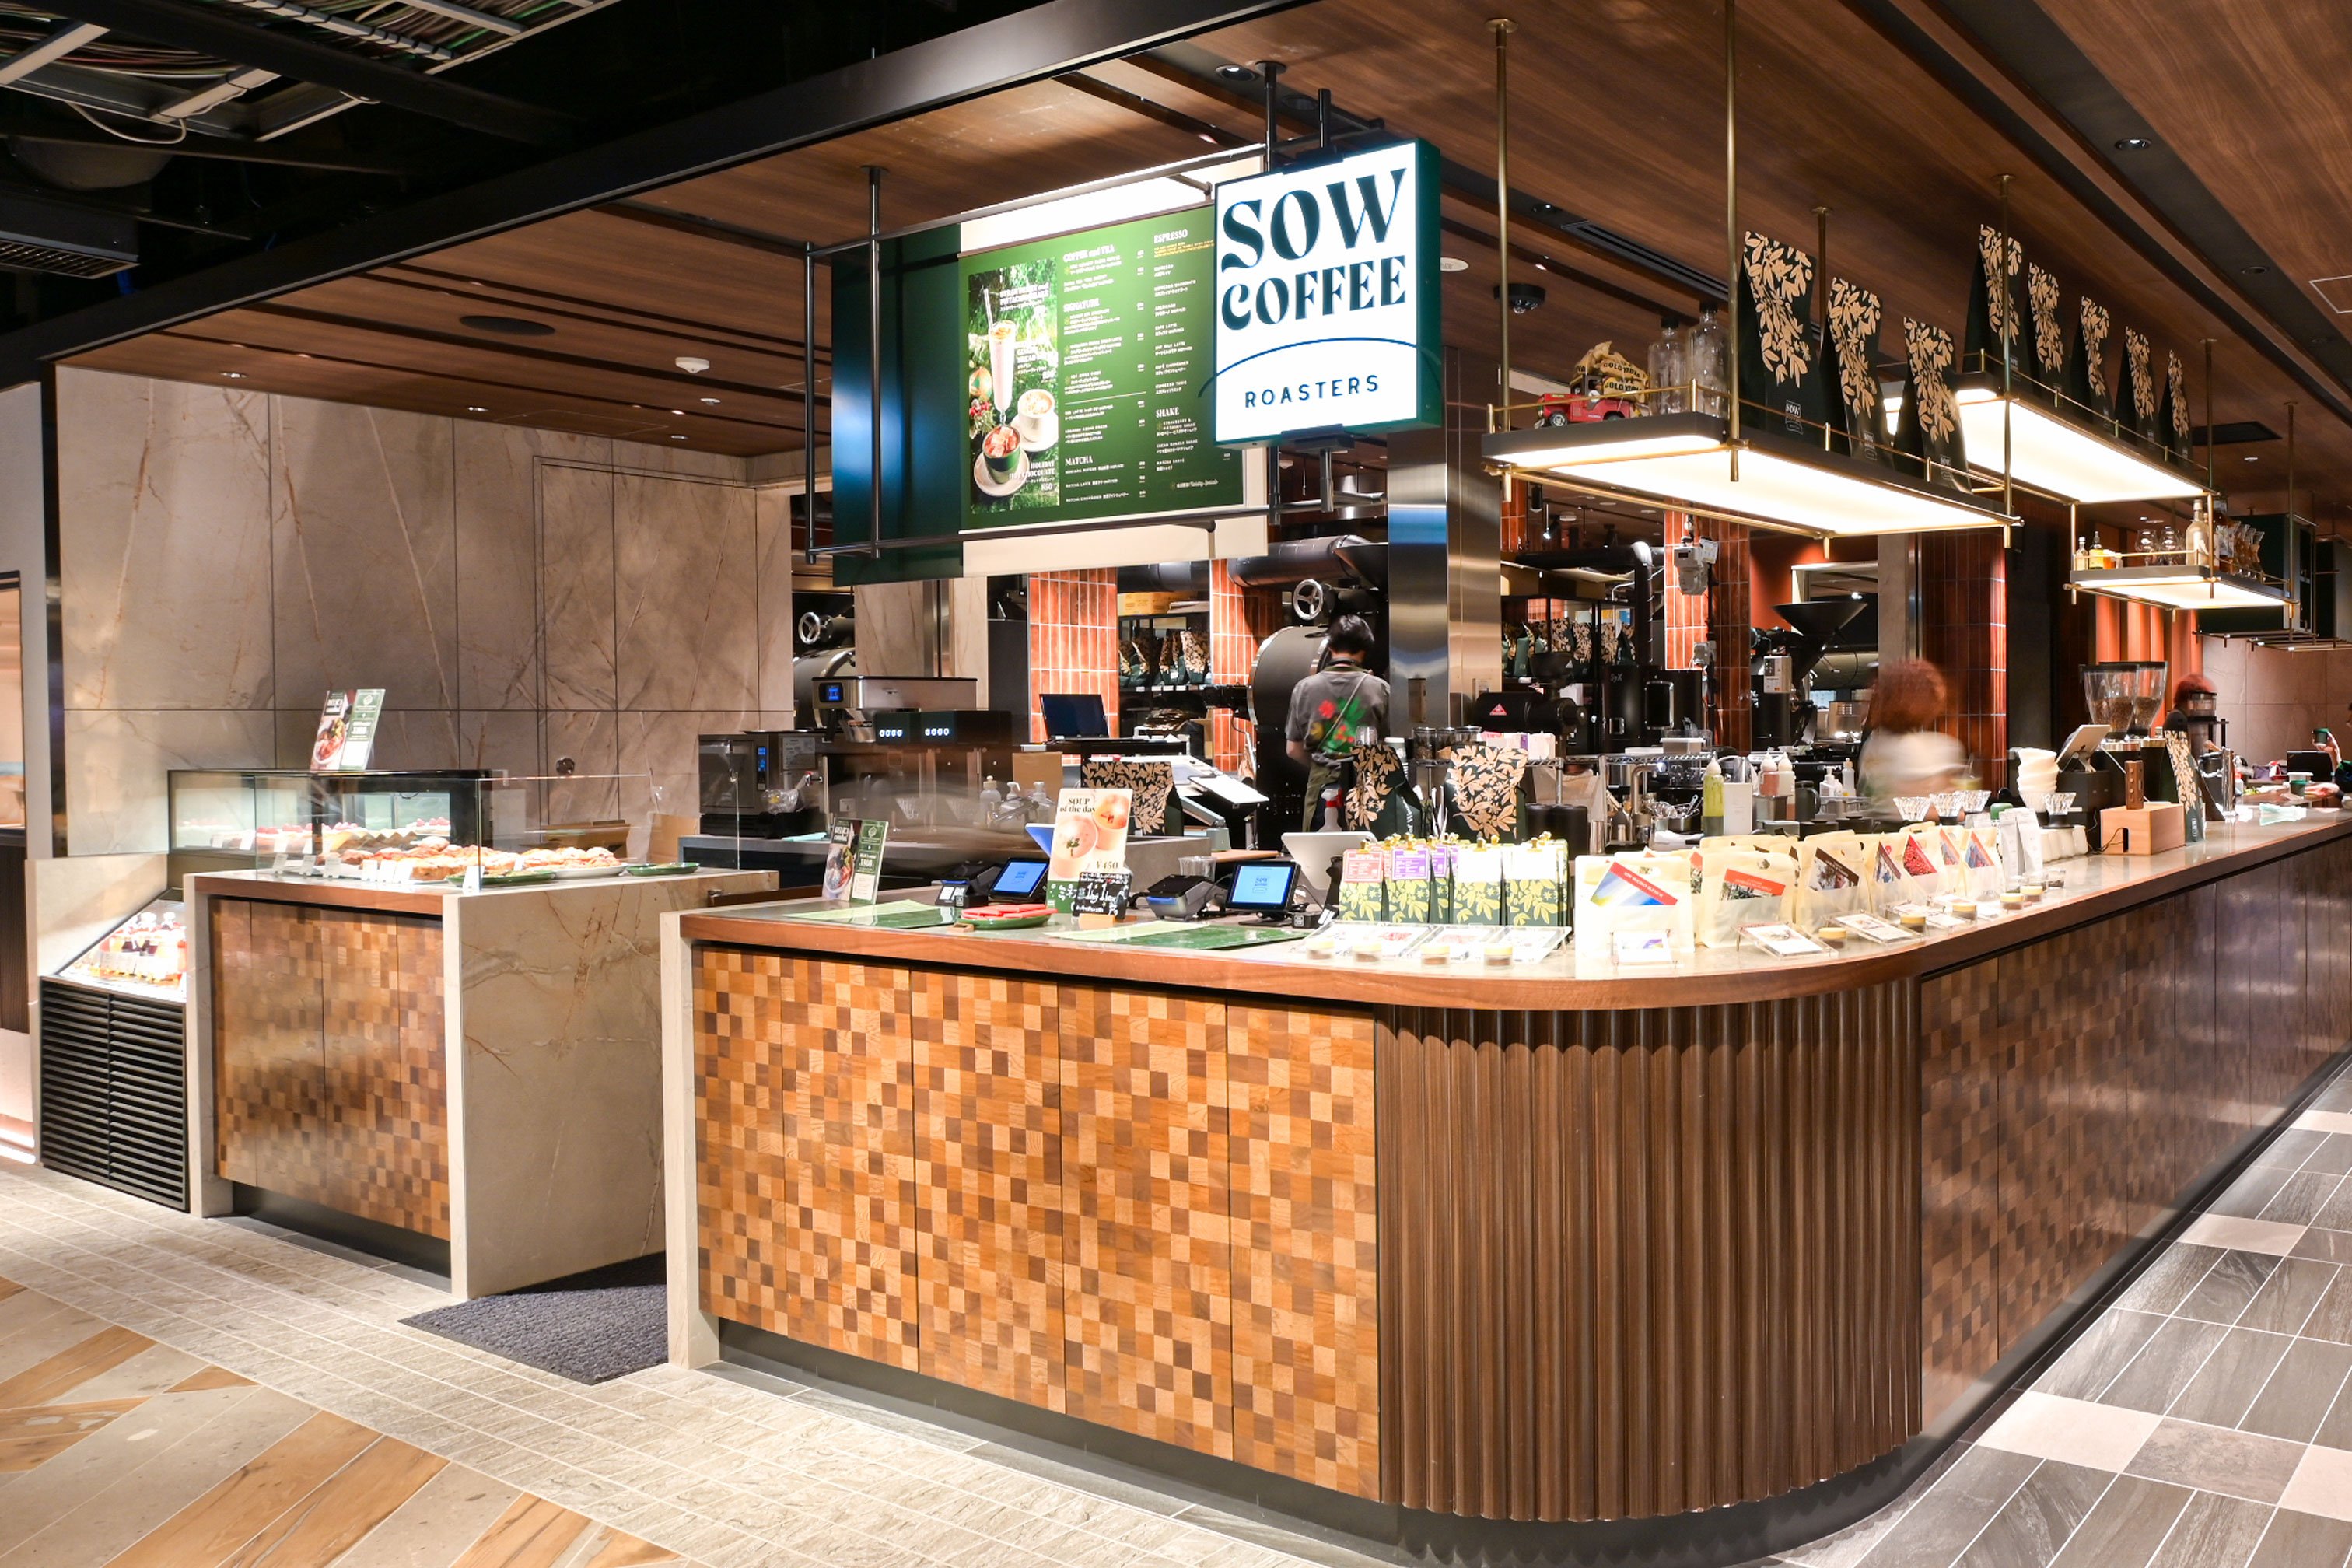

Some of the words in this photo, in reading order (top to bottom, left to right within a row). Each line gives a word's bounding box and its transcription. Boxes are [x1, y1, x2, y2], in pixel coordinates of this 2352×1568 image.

[1221, 167, 1407, 274] SOW
[1154, 229, 1188, 244] ESPRESSO
[1063, 250, 1088, 262] COFFEE
[1101, 243, 1115, 254] TEA
[1222, 255, 1405, 331] COFFEE
[1063, 298, 1099, 313] SIGNATURE
[1603, 362, 1640, 378] COLOMBIA
[1245, 375, 1379, 408] ROASTERS
[1156, 407, 1179, 418] SHAKE
[1031, 460, 1055, 469] HOLIDAY
[1065, 455, 1093, 467] MATCHA
[1083, 805, 1096, 814] day
